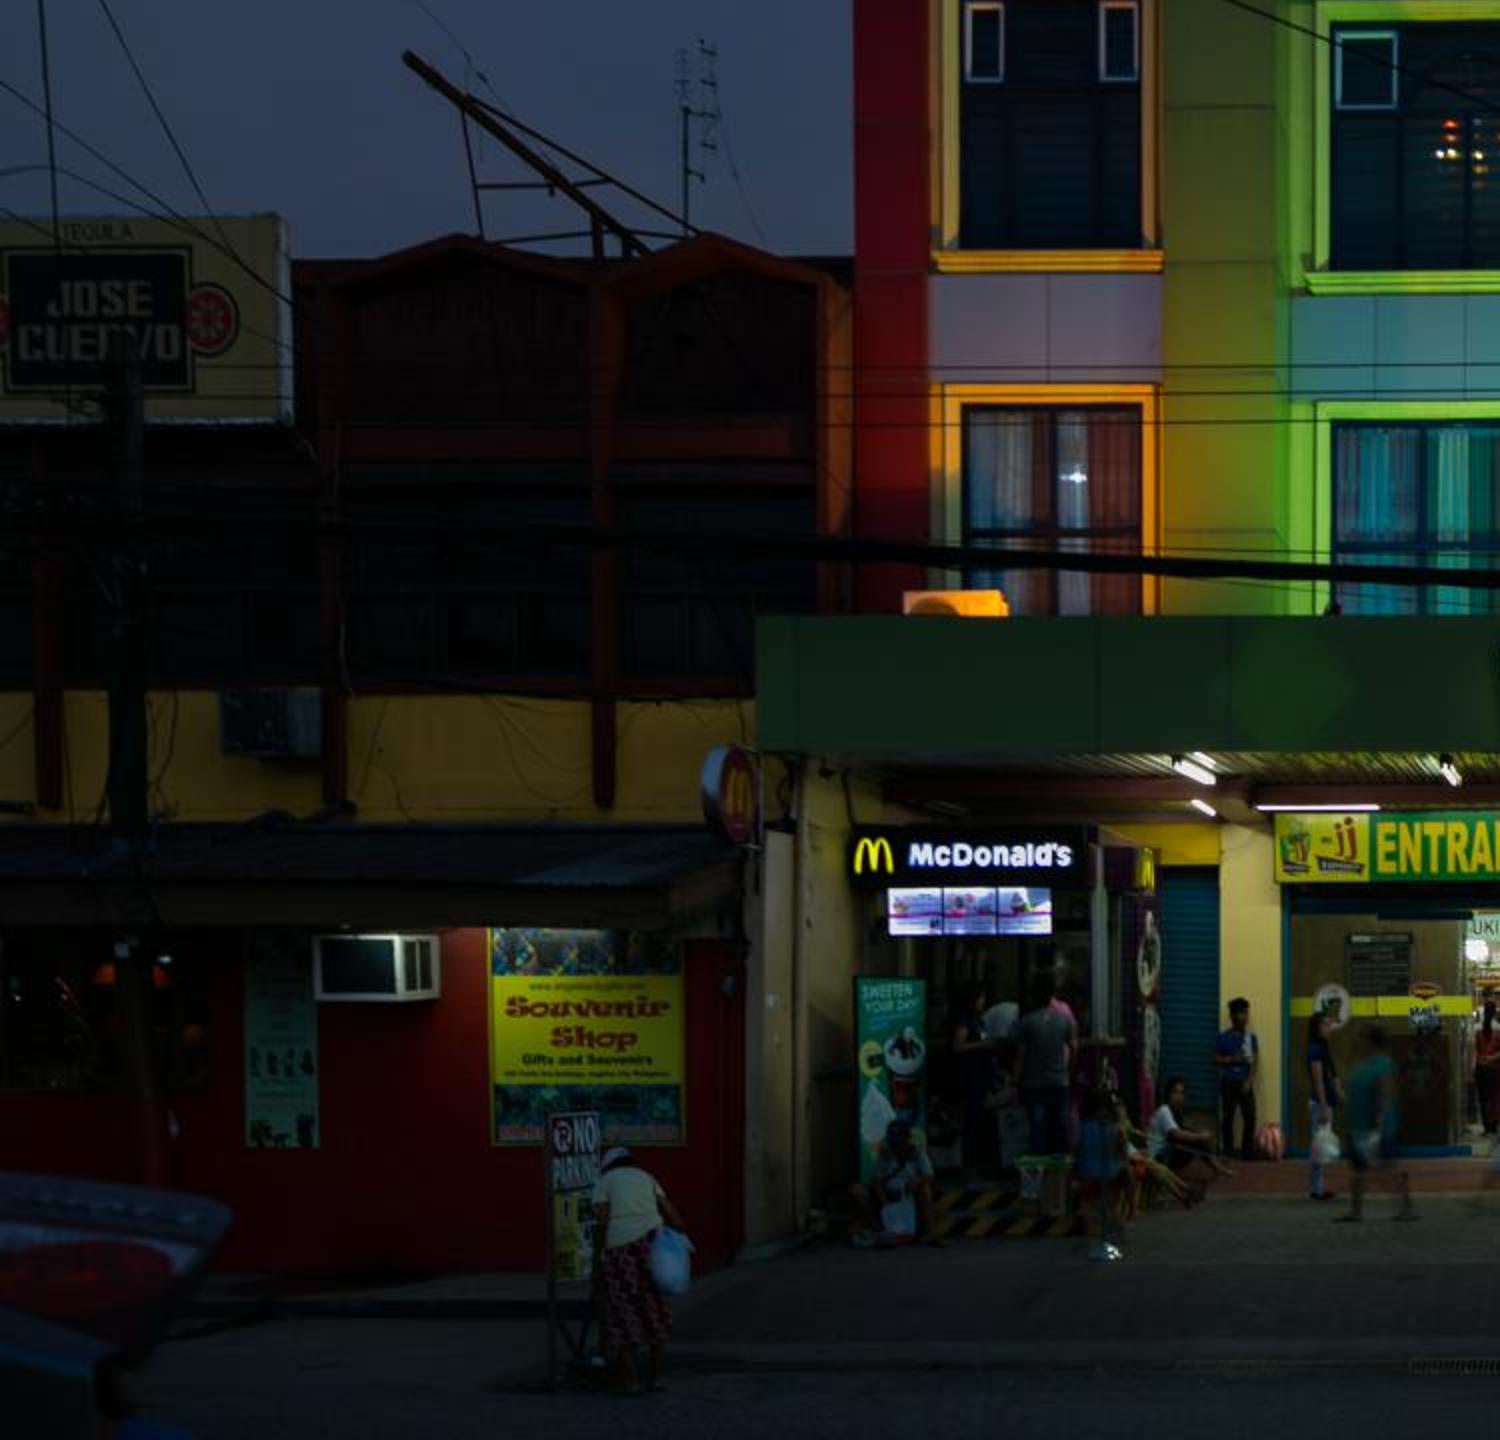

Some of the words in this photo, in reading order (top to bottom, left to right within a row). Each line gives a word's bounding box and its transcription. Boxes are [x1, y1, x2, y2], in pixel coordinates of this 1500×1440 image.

[62, 224, 134, 241] TEQUILA
[47, 279, 154, 319] JOSE
[908, 841, 1074, 868] McDonald's
[506, 995, 670, 1018] Souvenir
[550, 1025, 639, 1052] Shop
